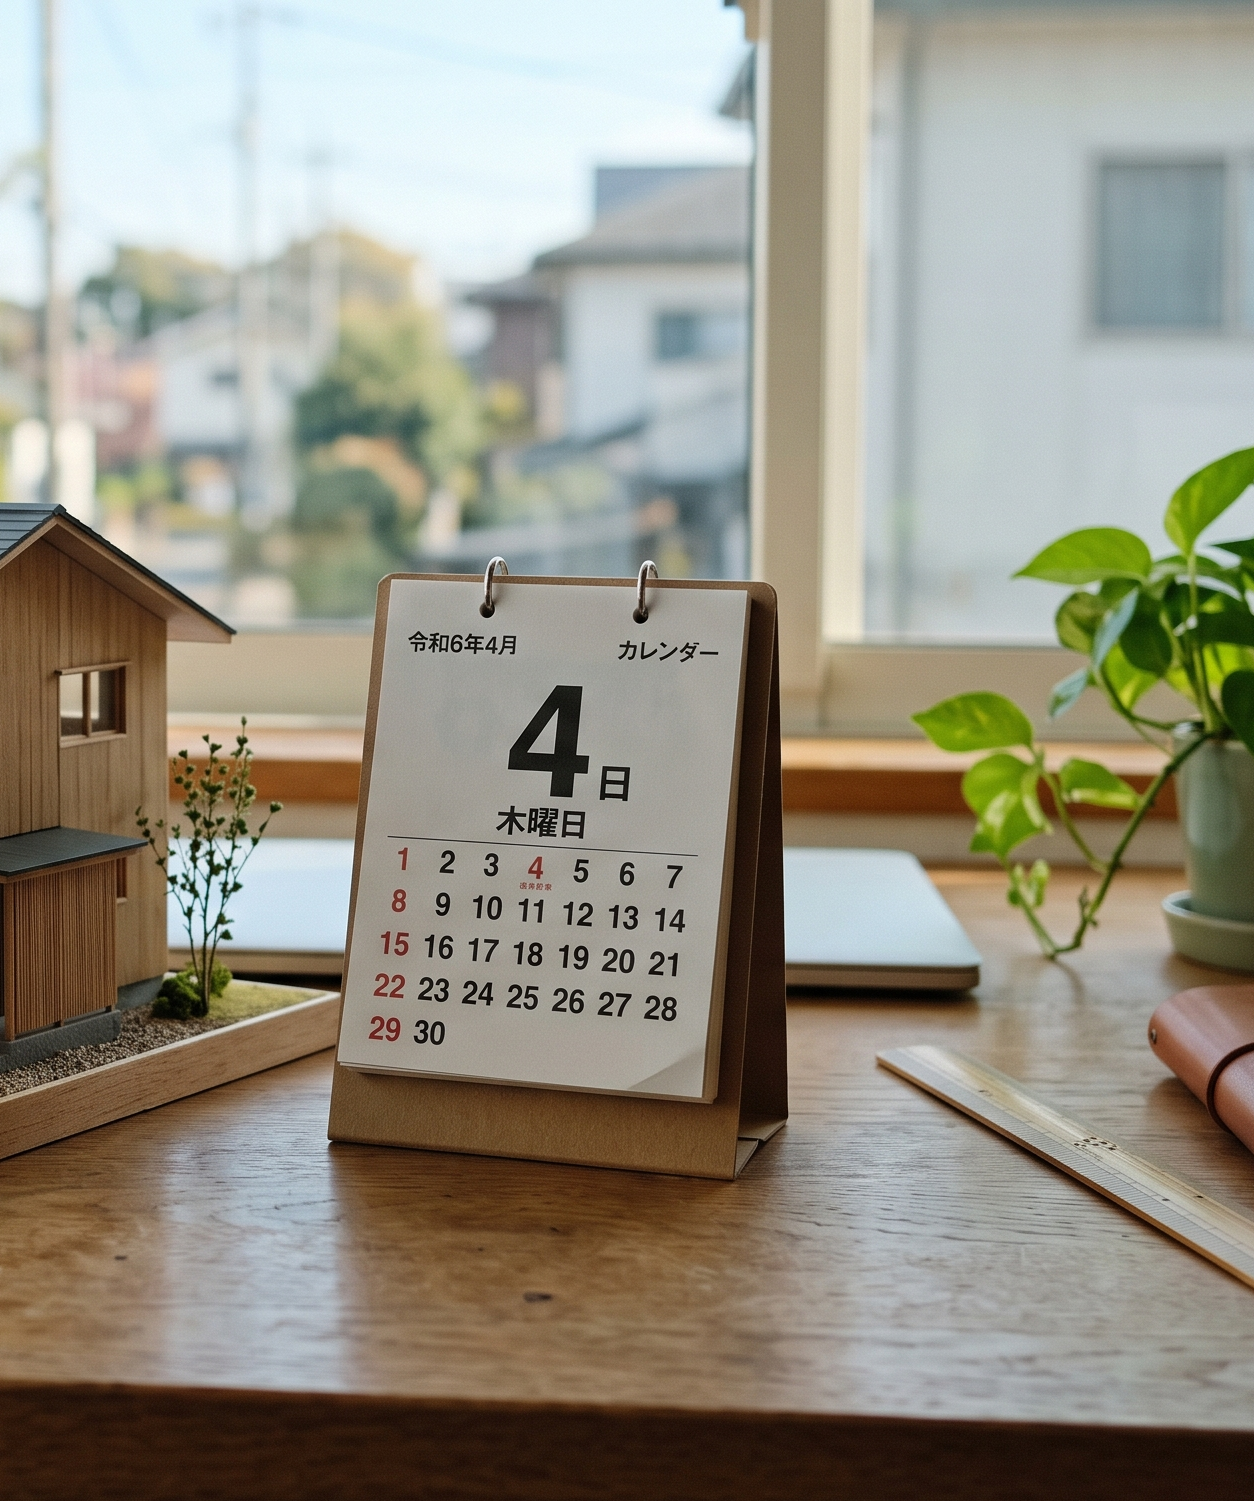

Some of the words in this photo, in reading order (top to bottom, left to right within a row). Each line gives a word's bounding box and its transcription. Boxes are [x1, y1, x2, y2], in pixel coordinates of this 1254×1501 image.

[407, 631, 517, 655] 令和6年4月
[617, 640, 719, 662] カレンダー
[495, 806, 586, 839] 木曜日
[397, 848, 409, 870] 1
[439, 850, 456, 873] 2
[483, 853, 499, 876] 3
[527, 857, 544, 879] 4
[573, 859, 590, 883] 5
[619, 862, 635, 886] 6
[666, 865, 684, 888] 7
[391, 889, 407, 912] 8
[435, 893, 451, 916] 9
[472, 895, 503, 920] 10
[518, 899, 544, 923] 11
[563, 902, 594, 926] 12
[608, 905, 639, 930] 13
[654, 908, 686, 932] 14
[380, 931, 410, 956] 15
[424, 935, 454, 959] 16
[468, 938, 500, 962] 17
[513, 942, 543, 966] 18
[558, 945, 589, 970] 19
[601, 948, 635, 973] 20
[647, 951, 679, 976] 21
[373, 973, 406, 998] 22
[417, 977, 450, 1002] 23
[461, 981, 494, 1006] 24
[506, 984, 539, 1010] 25
[551, 988, 585, 1013] 26
[597, 992, 633, 1017] 27
[643, 996, 678, 1021] 28
[368, 1016, 401, 1041] 29
[413, 1020, 446, 1045] 30
